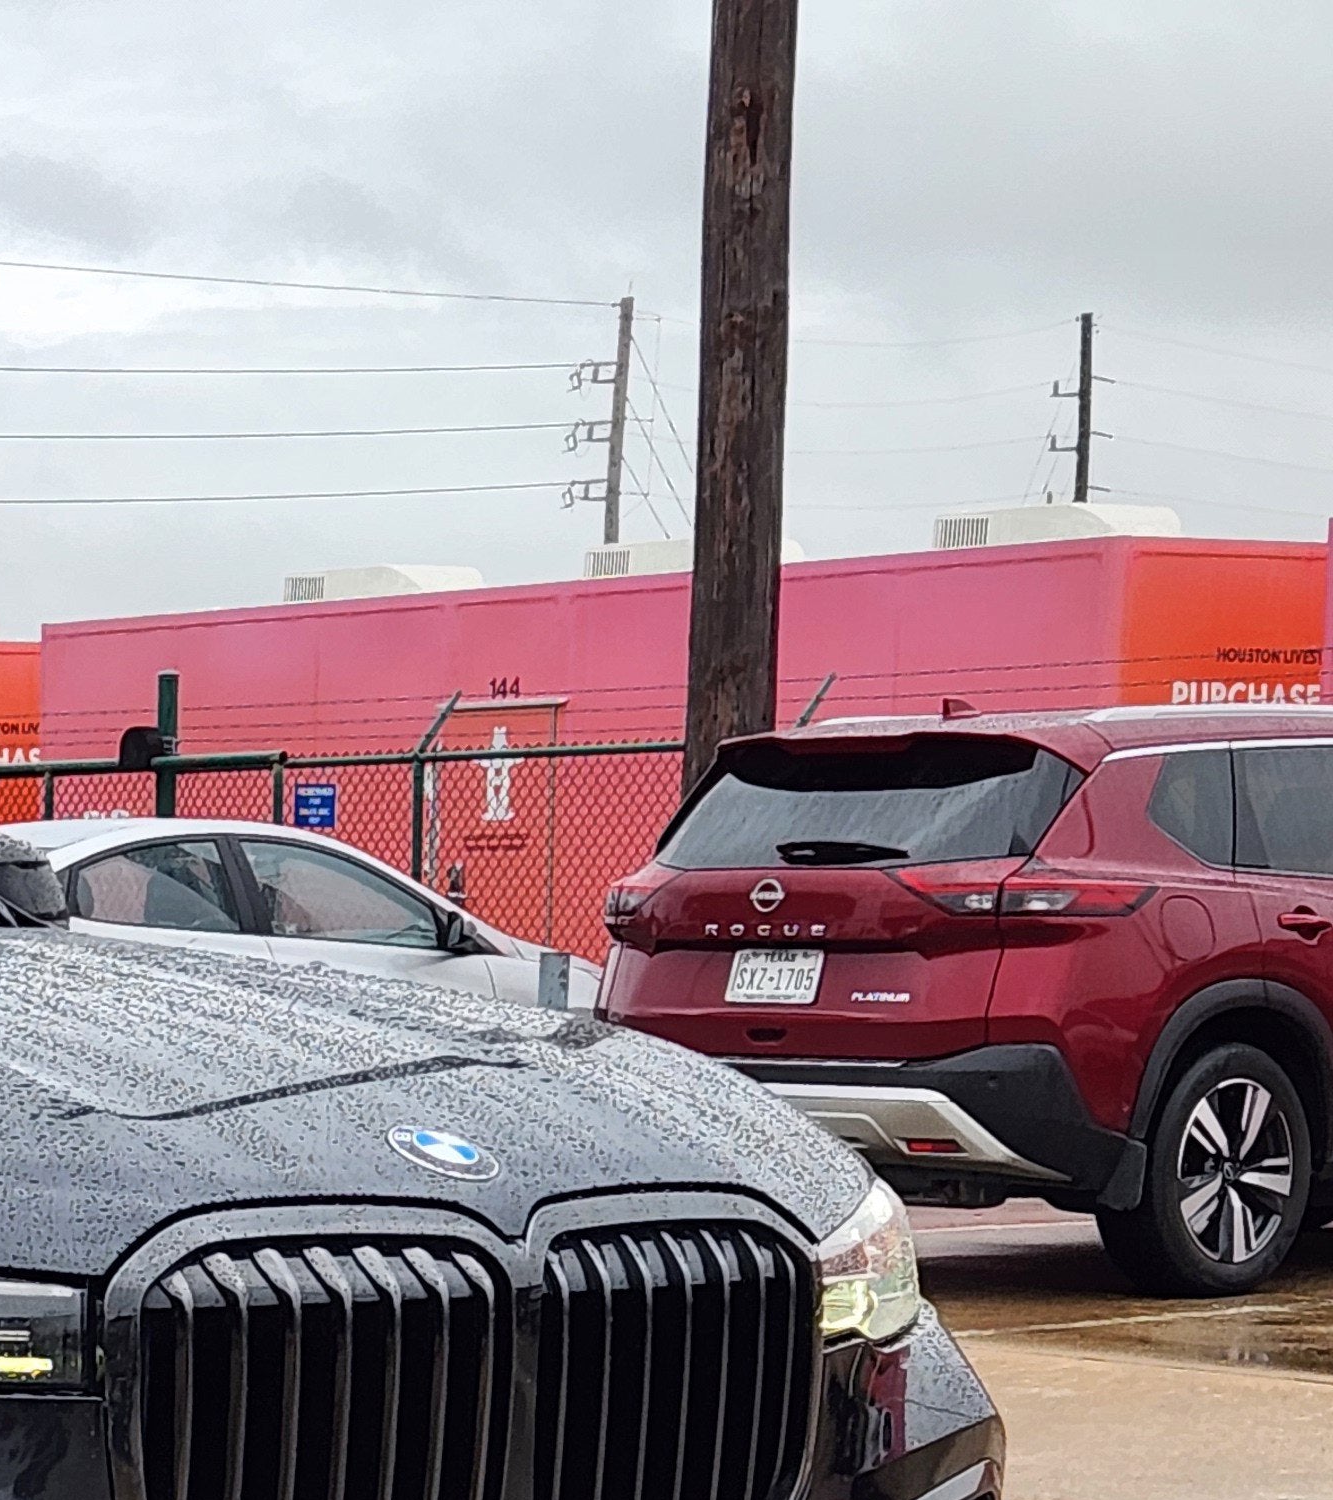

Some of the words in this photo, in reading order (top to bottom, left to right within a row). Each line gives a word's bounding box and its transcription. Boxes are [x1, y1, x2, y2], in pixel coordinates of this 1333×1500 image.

[1216, 647, 1281, 663] HOUSTON
[489, 676, 520, 699] 144
[1171, 680, 1321, 704] PURCHASE
[704, 923, 826, 937] ROGUE
